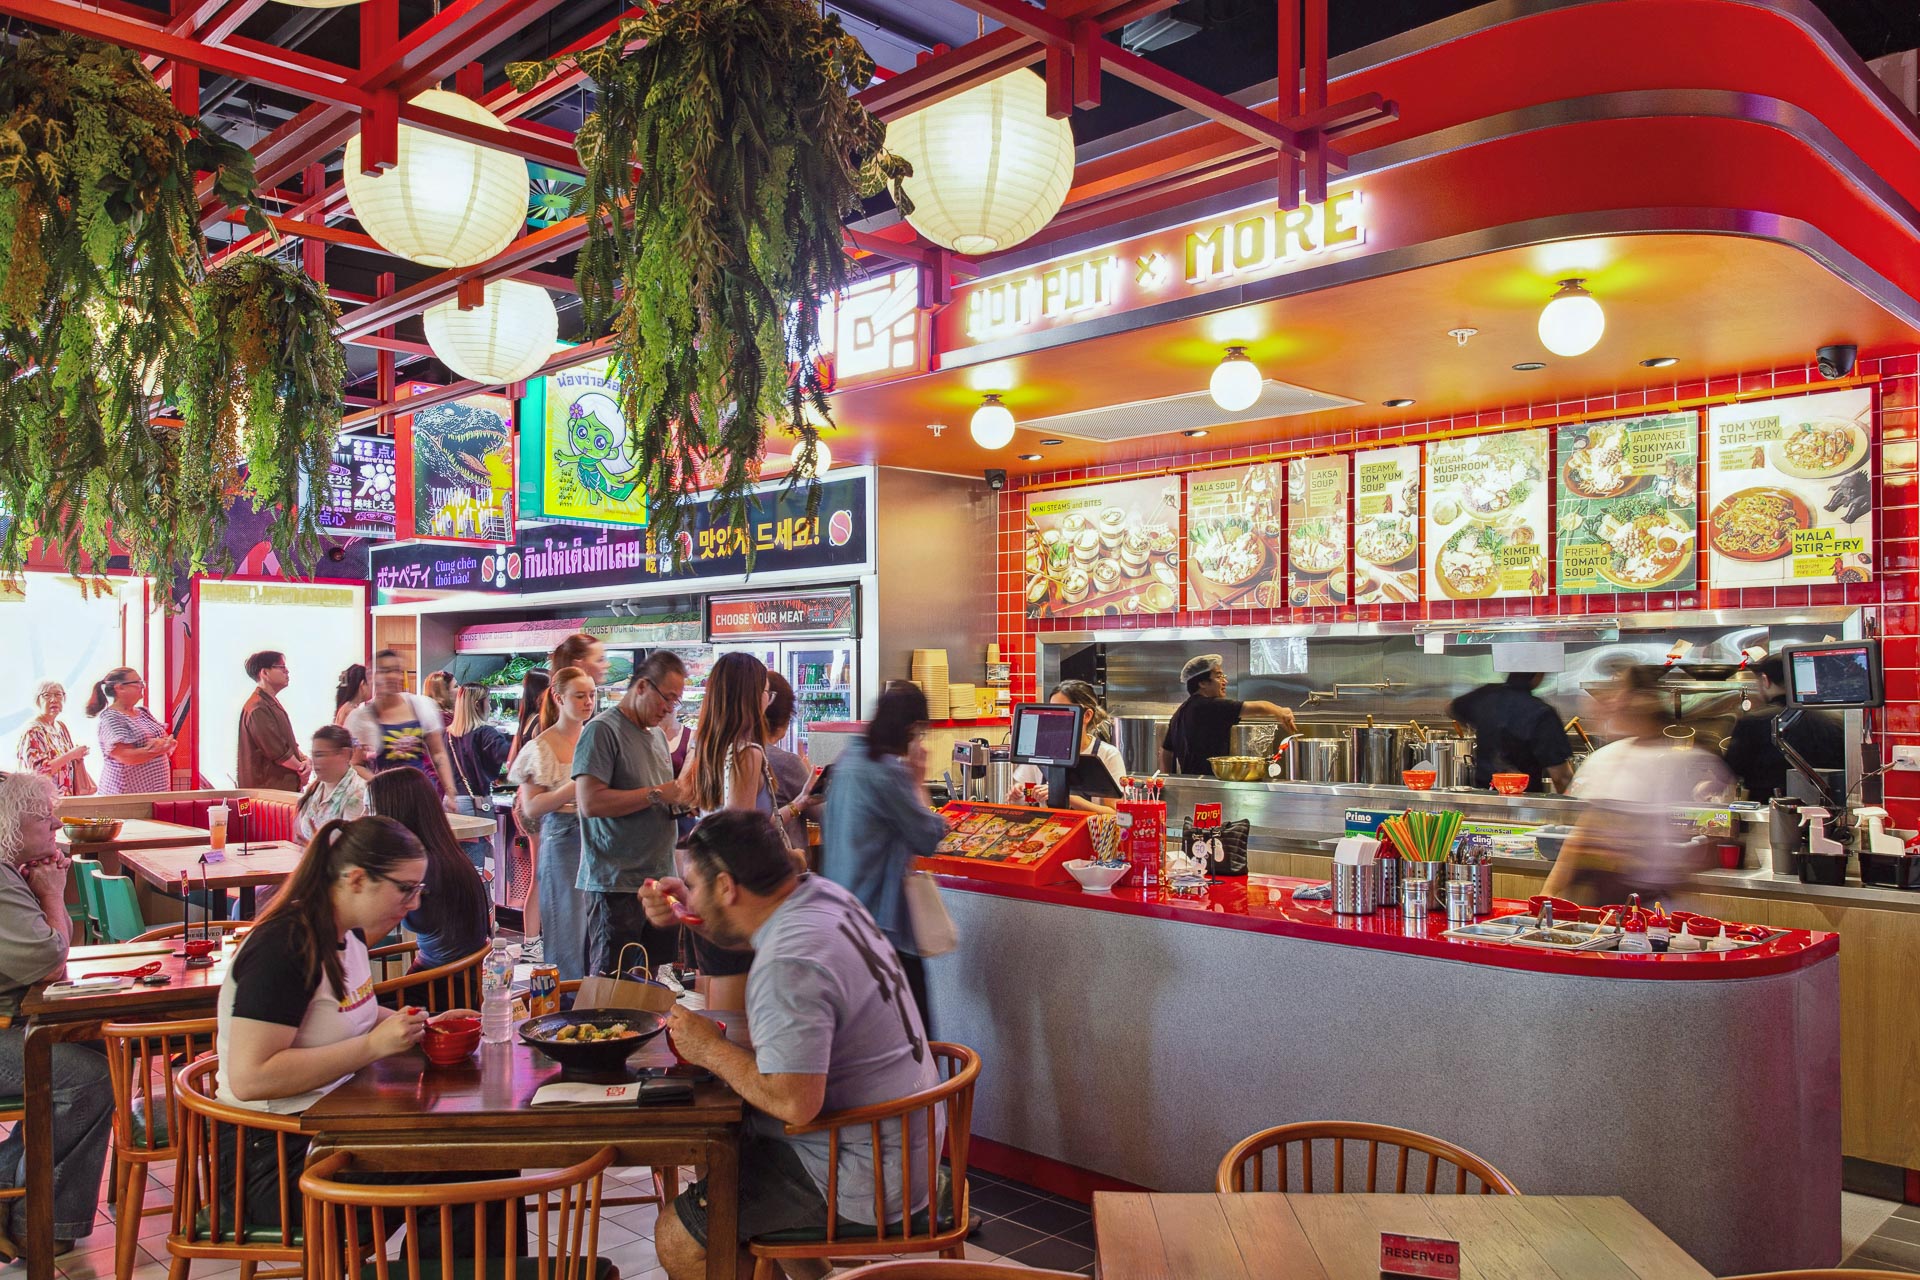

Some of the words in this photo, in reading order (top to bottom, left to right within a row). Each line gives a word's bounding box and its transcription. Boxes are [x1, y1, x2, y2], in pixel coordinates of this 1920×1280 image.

[1042, 257, 1112, 317] POT
[1186, 190, 1363, 283] MORE
[557, 371, 624, 392] น้องว่าอร่อ
[1719, 422, 1745, 434] TOM
[1749, 418, 1777, 430] YUM
[1632, 429, 1686, 444] JAPANESE
[1632, 440, 1685, 454] SUKIYAKI
[1433, 454, 1464, 465] VEGAN
[1632, 453, 1663, 464] SOUP
[1360, 463, 1396, 475] CREAMY
[1433, 461, 1489, 474] MUSHROOM
[1311, 470, 1338, 480] LAKSA
[1361, 474, 1379, 483] TOM
[1382, 471, 1402, 481] YUM
[1433, 473, 1459, 484] SOUP
[1193, 484, 1213, 492] MALA
[1215, 481, 1236, 490] SOUP
[1311, 479, 1334, 489] SOUP
[1361, 482, 1385, 493] SOUP
[1032, 505, 1046, 513] MINI
[1046, 503, 1070, 512] STEAMS
[1084, 499, 1102, 508] BITES
[319, 511, 347, 526] 点心
[1795, 530, 1833, 542] MALA
[1503, 546, 1539, 556] KIMCHI
[1565, 547, 1598, 557] FRESH
[1795, 540, 1860, 553] STIR-FRY
[524, 528, 640, 579] กินให้เต็มที่เลย
[435, 560, 456, 574] Cùng
[457, 558, 477, 570] chén
[1503, 556, 1530, 566] SOUP
[1565, 556, 1608, 567] TOMATO
[377, 563, 431, 589] ボナペティ
[1565, 567, 1594, 577] SOUP
[452, 572, 470, 585] nào!
[715, 612, 750, 626] CHOOSE
[751, 611, 777, 624] YOUR
[779, 610, 805, 623] MEAT
[585, 624, 608, 634] CHOOSE
[610, 623, 628, 633] YOUR
[458, 633, 478, 641] CHOOSE
[1346, 811, 1371, 821] Primo
[1472, 835, 1492, 846] cling
[533, 976, 557, 991] NTA
[1385, 1246, 1455, 1265] RESERVED
